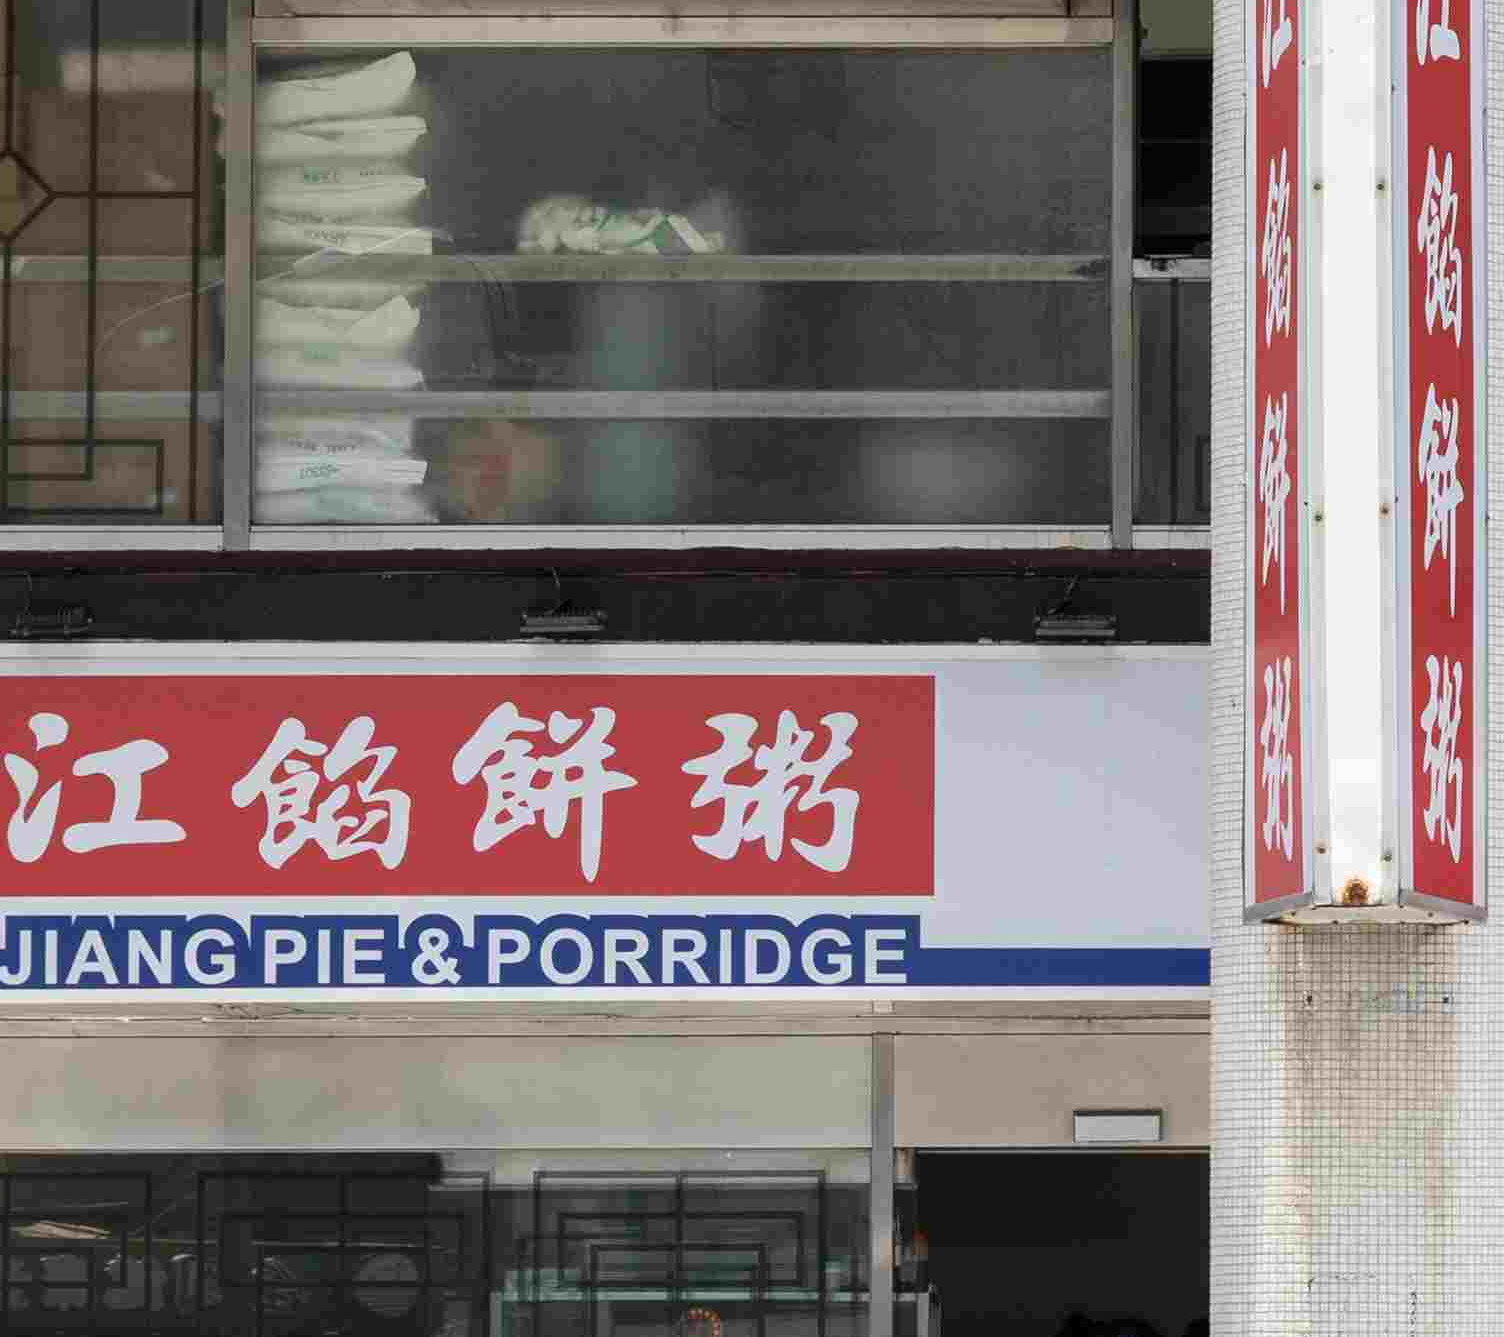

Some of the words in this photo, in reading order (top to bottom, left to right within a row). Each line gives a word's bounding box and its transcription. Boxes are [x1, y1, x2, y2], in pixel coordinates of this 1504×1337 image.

[262, 929, 386, 987] PIE
[410, 929, 462, 987] &
[486, 929, 910, 987] PORRIDGE
